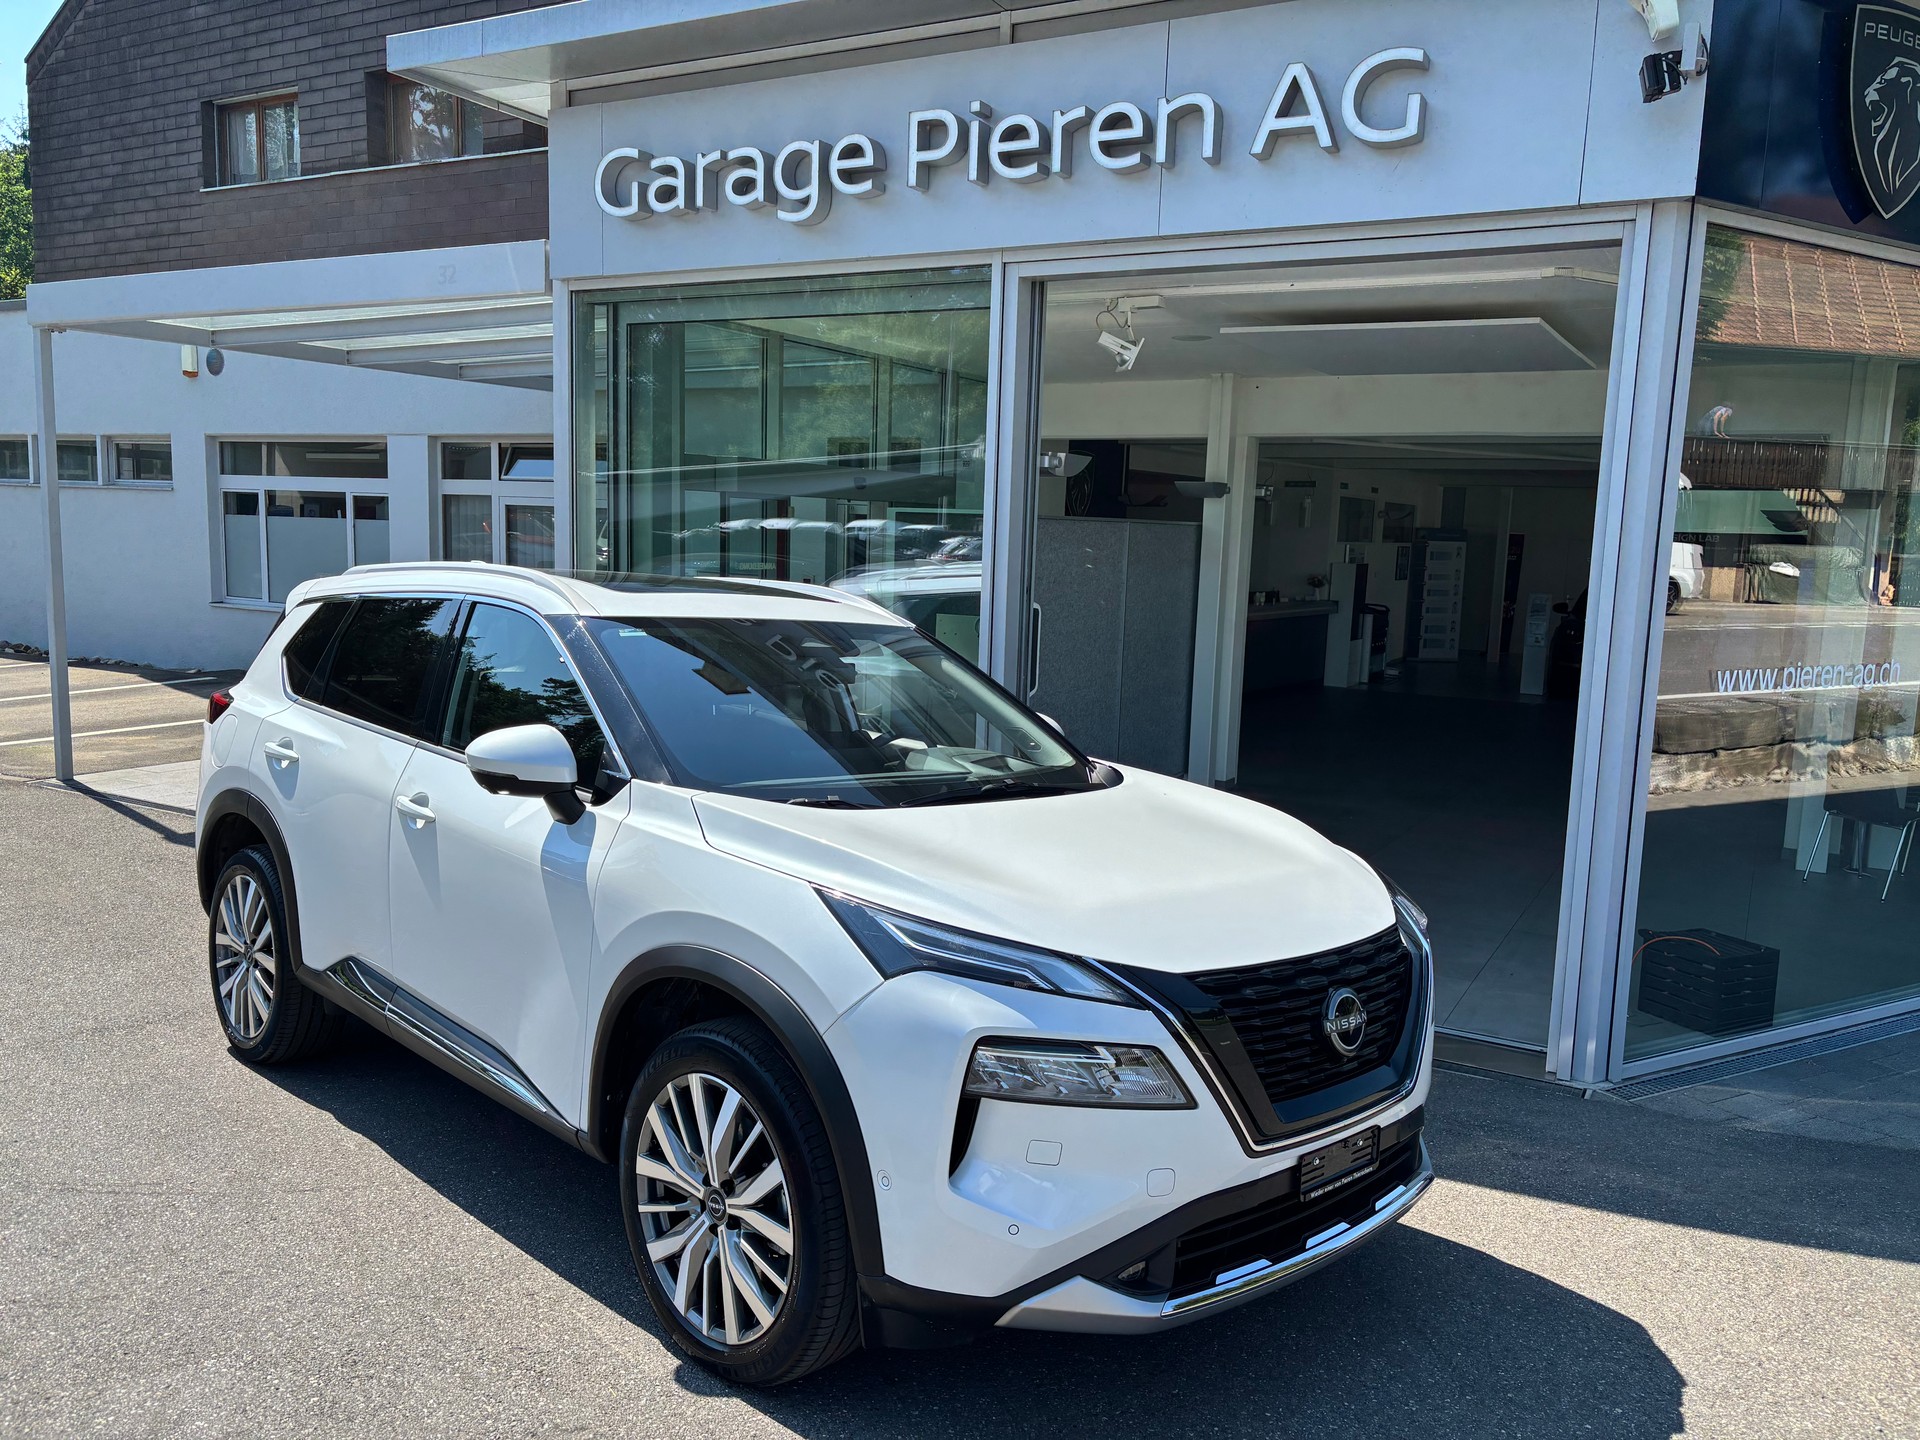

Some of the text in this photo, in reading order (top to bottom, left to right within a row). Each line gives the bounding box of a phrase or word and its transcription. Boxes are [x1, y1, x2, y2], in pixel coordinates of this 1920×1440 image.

[594, 46, 1430, 224] Garage Pieren AG
[438, 264, 457, 285] 32
[1699, 534, 1720, 543] LAB
[1717, 659, 1901, 694] www.pieren-ag.ch
[1326, 1011, 1367, 1033] NISSAN
